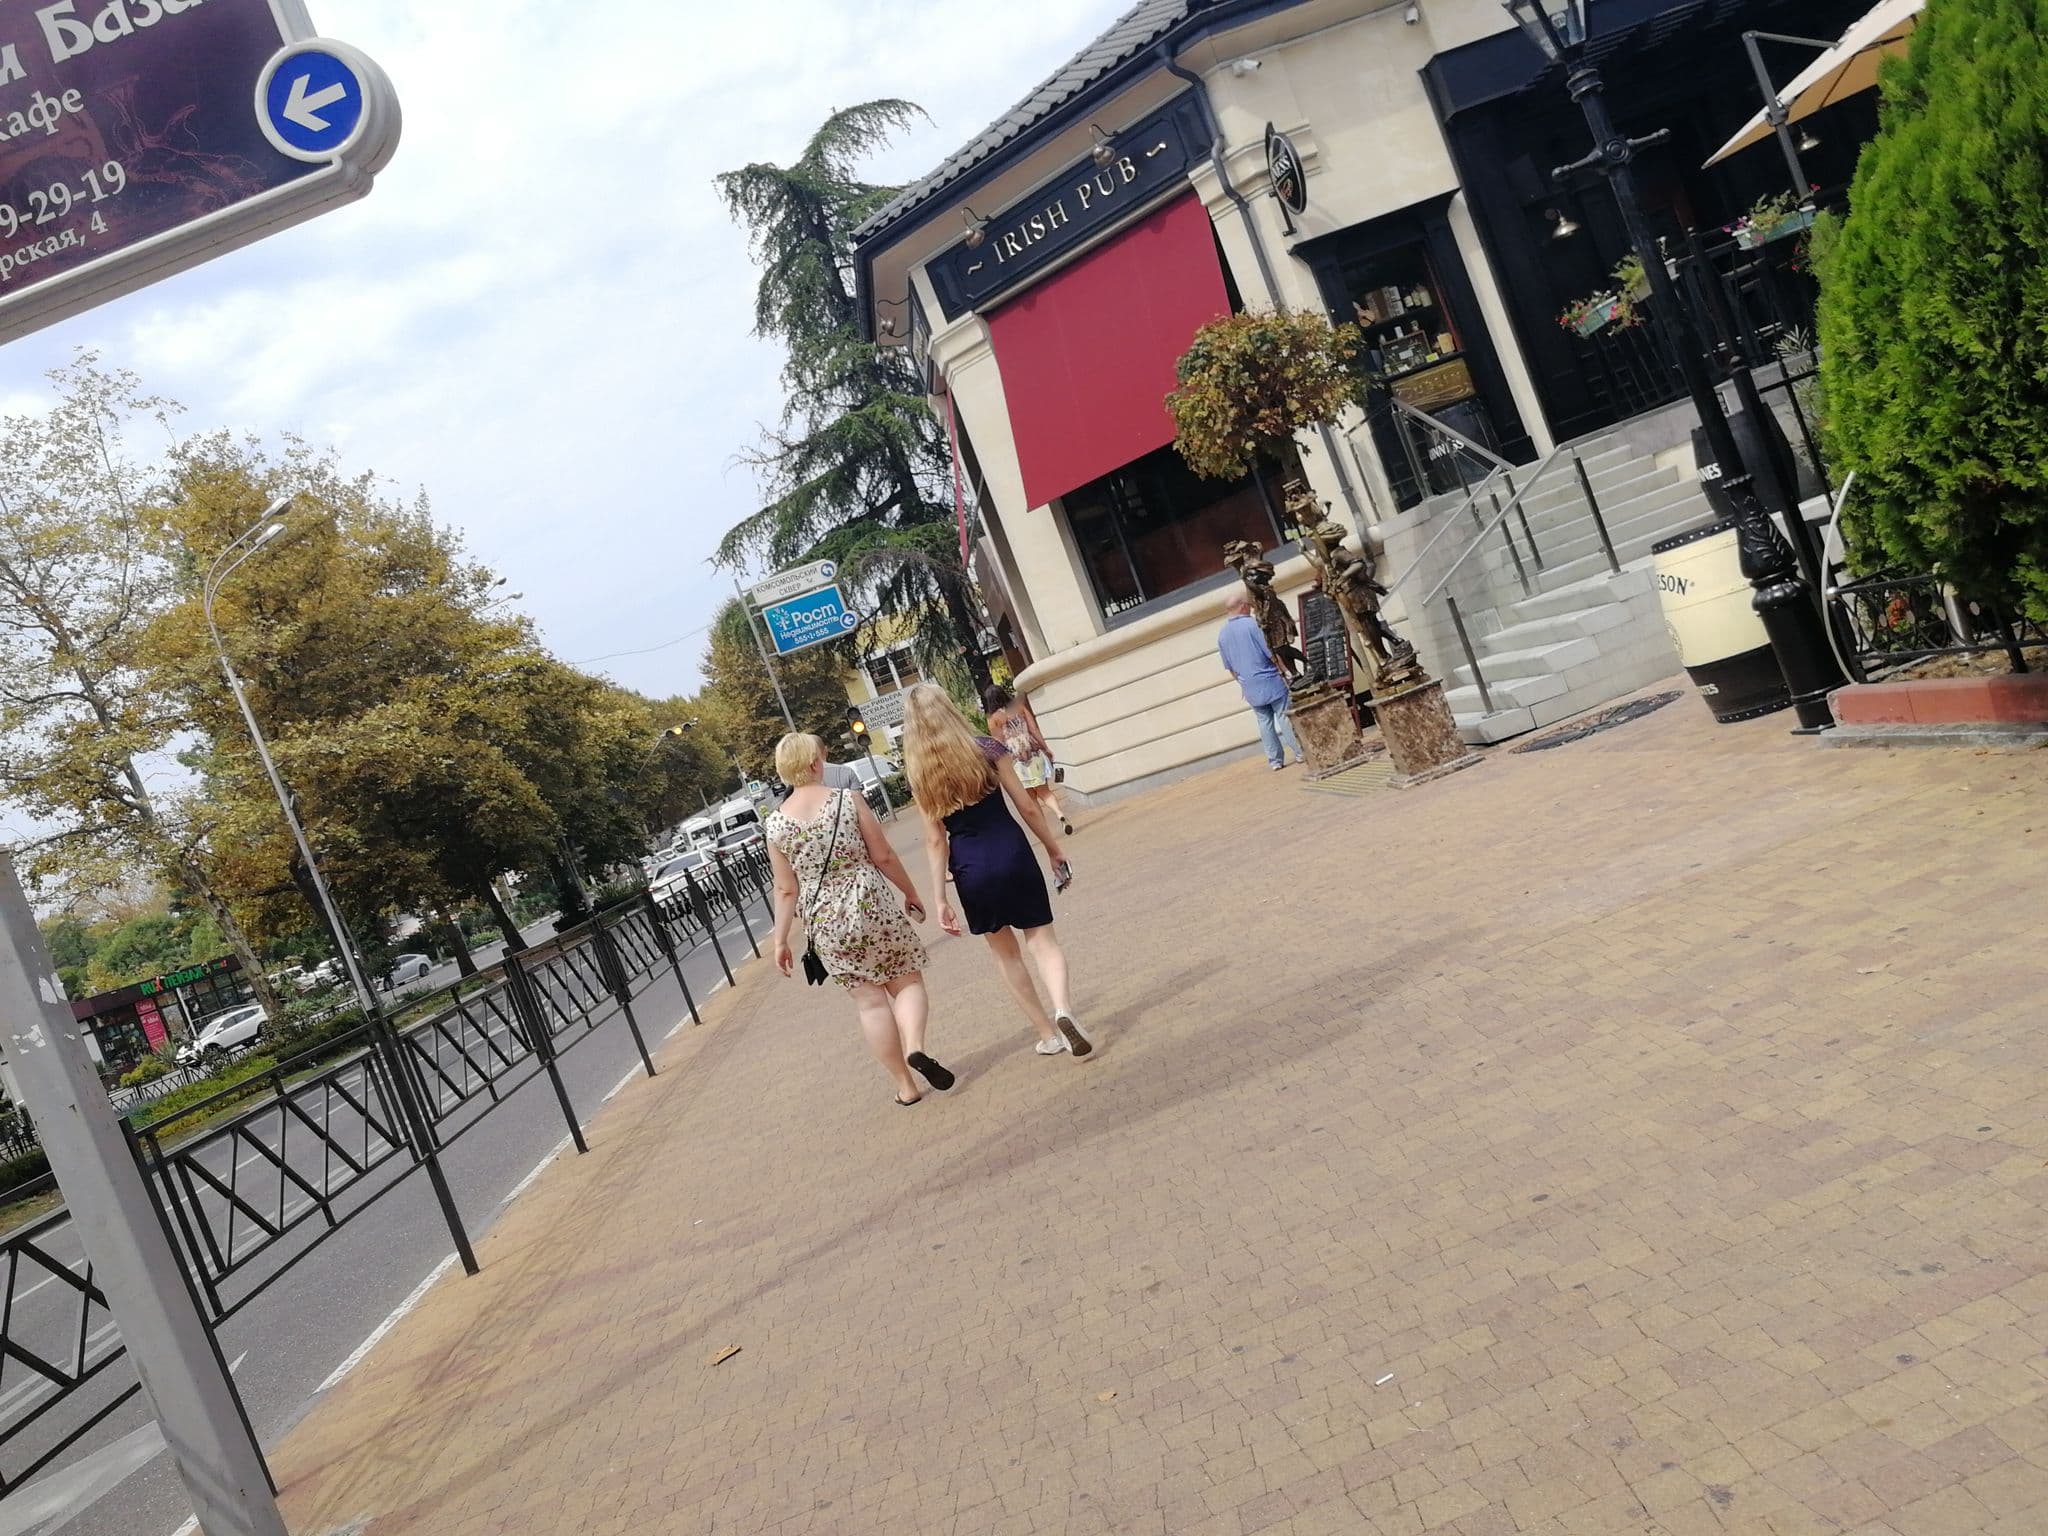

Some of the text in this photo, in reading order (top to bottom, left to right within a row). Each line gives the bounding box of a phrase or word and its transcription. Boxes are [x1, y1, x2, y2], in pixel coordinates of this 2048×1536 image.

[91, 210, 109, 235] 4
[992, 156, 1137, 265] IRISH PUB
[756, 567, 818, 593] КОМСОМОЛЬСКИЙ
[779, 583, 801, 597] СКВЕР
[1656, 573, 1688, 596] SON
[780, 616, 839, 640] Недвижимость
[791, 603, 838, 628] Рост
